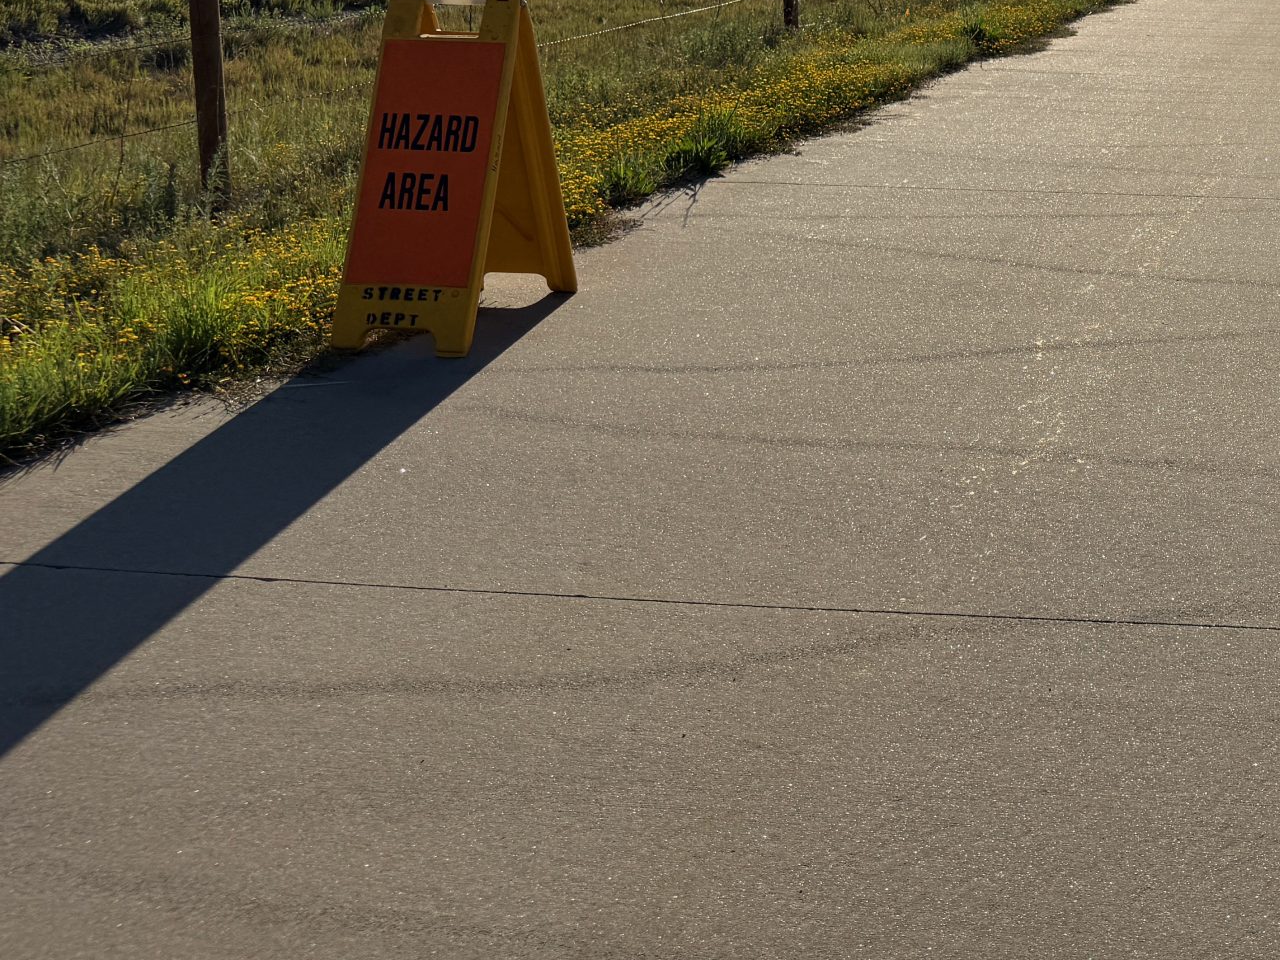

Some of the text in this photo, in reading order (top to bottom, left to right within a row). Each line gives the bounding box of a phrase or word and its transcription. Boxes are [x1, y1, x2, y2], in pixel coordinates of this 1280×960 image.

[378, 113, 480, 152] HAZARD
[379, 172, 449, 211] AREA
[361, 287, 442, 302] STREET
[366, 312, 419, 326] DEPT
